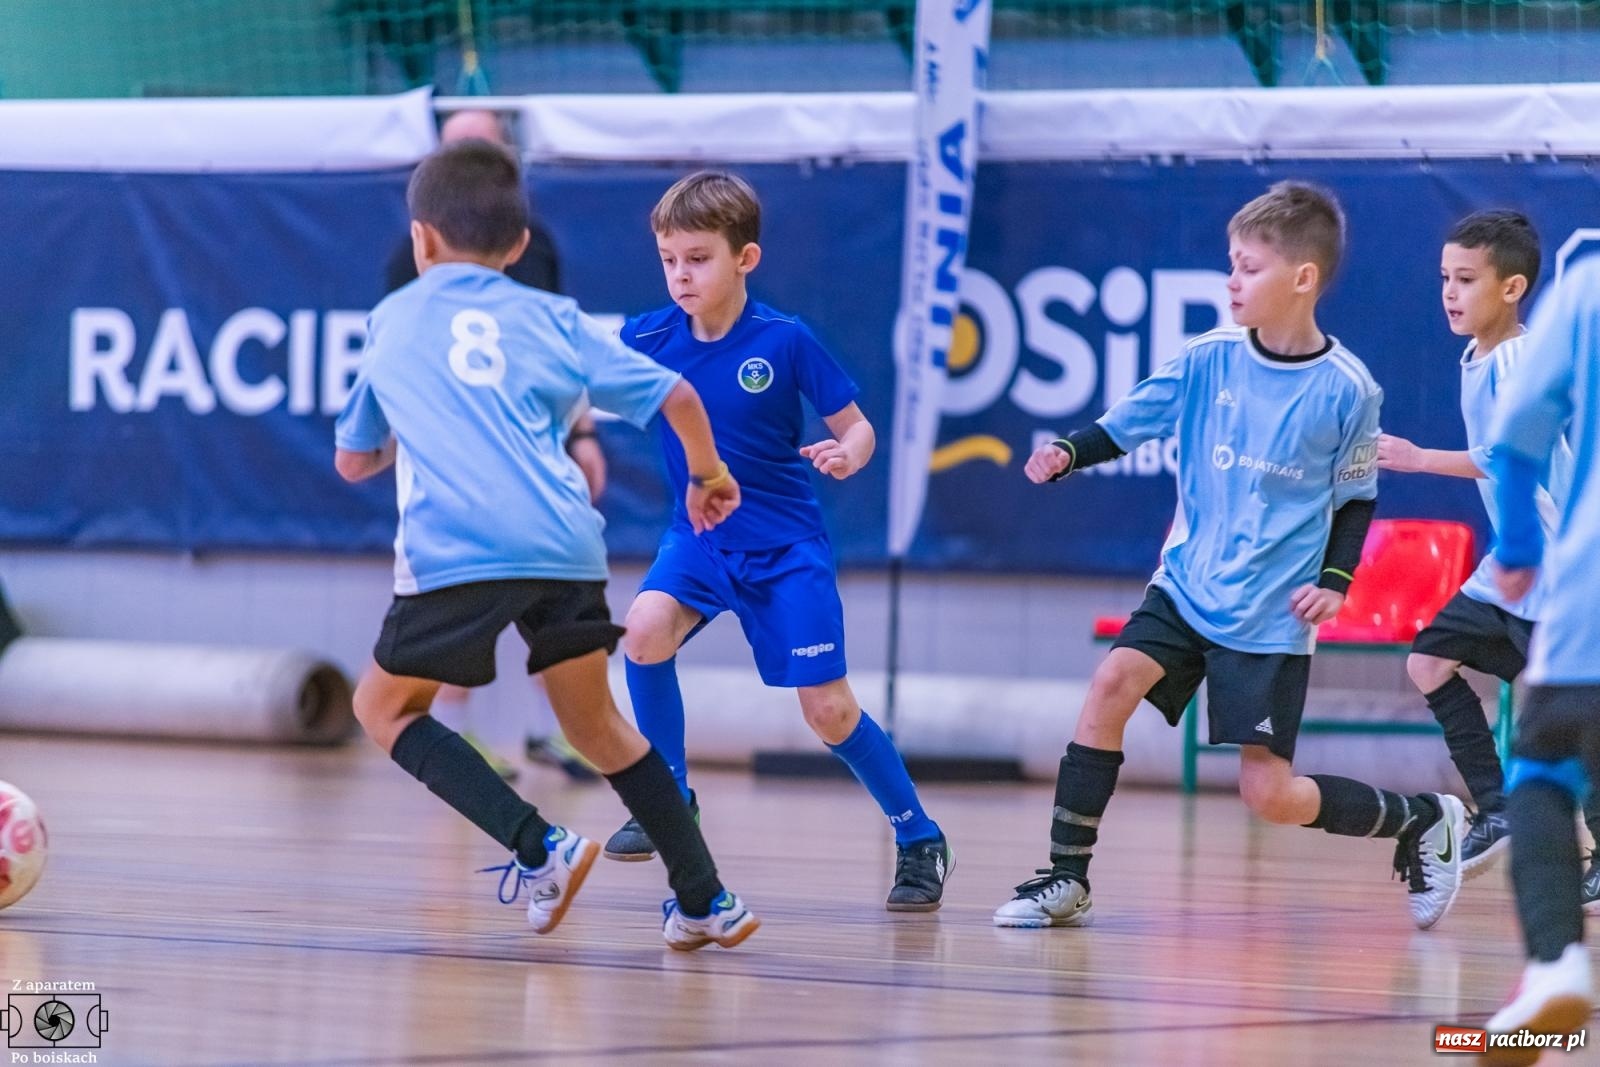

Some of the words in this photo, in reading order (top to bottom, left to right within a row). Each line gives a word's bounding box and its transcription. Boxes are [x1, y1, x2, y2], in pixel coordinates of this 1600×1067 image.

[447, 309, 506, 387] 8
[747, 362, 764, 370] MKS
[791, 642, 835, 658] regio
